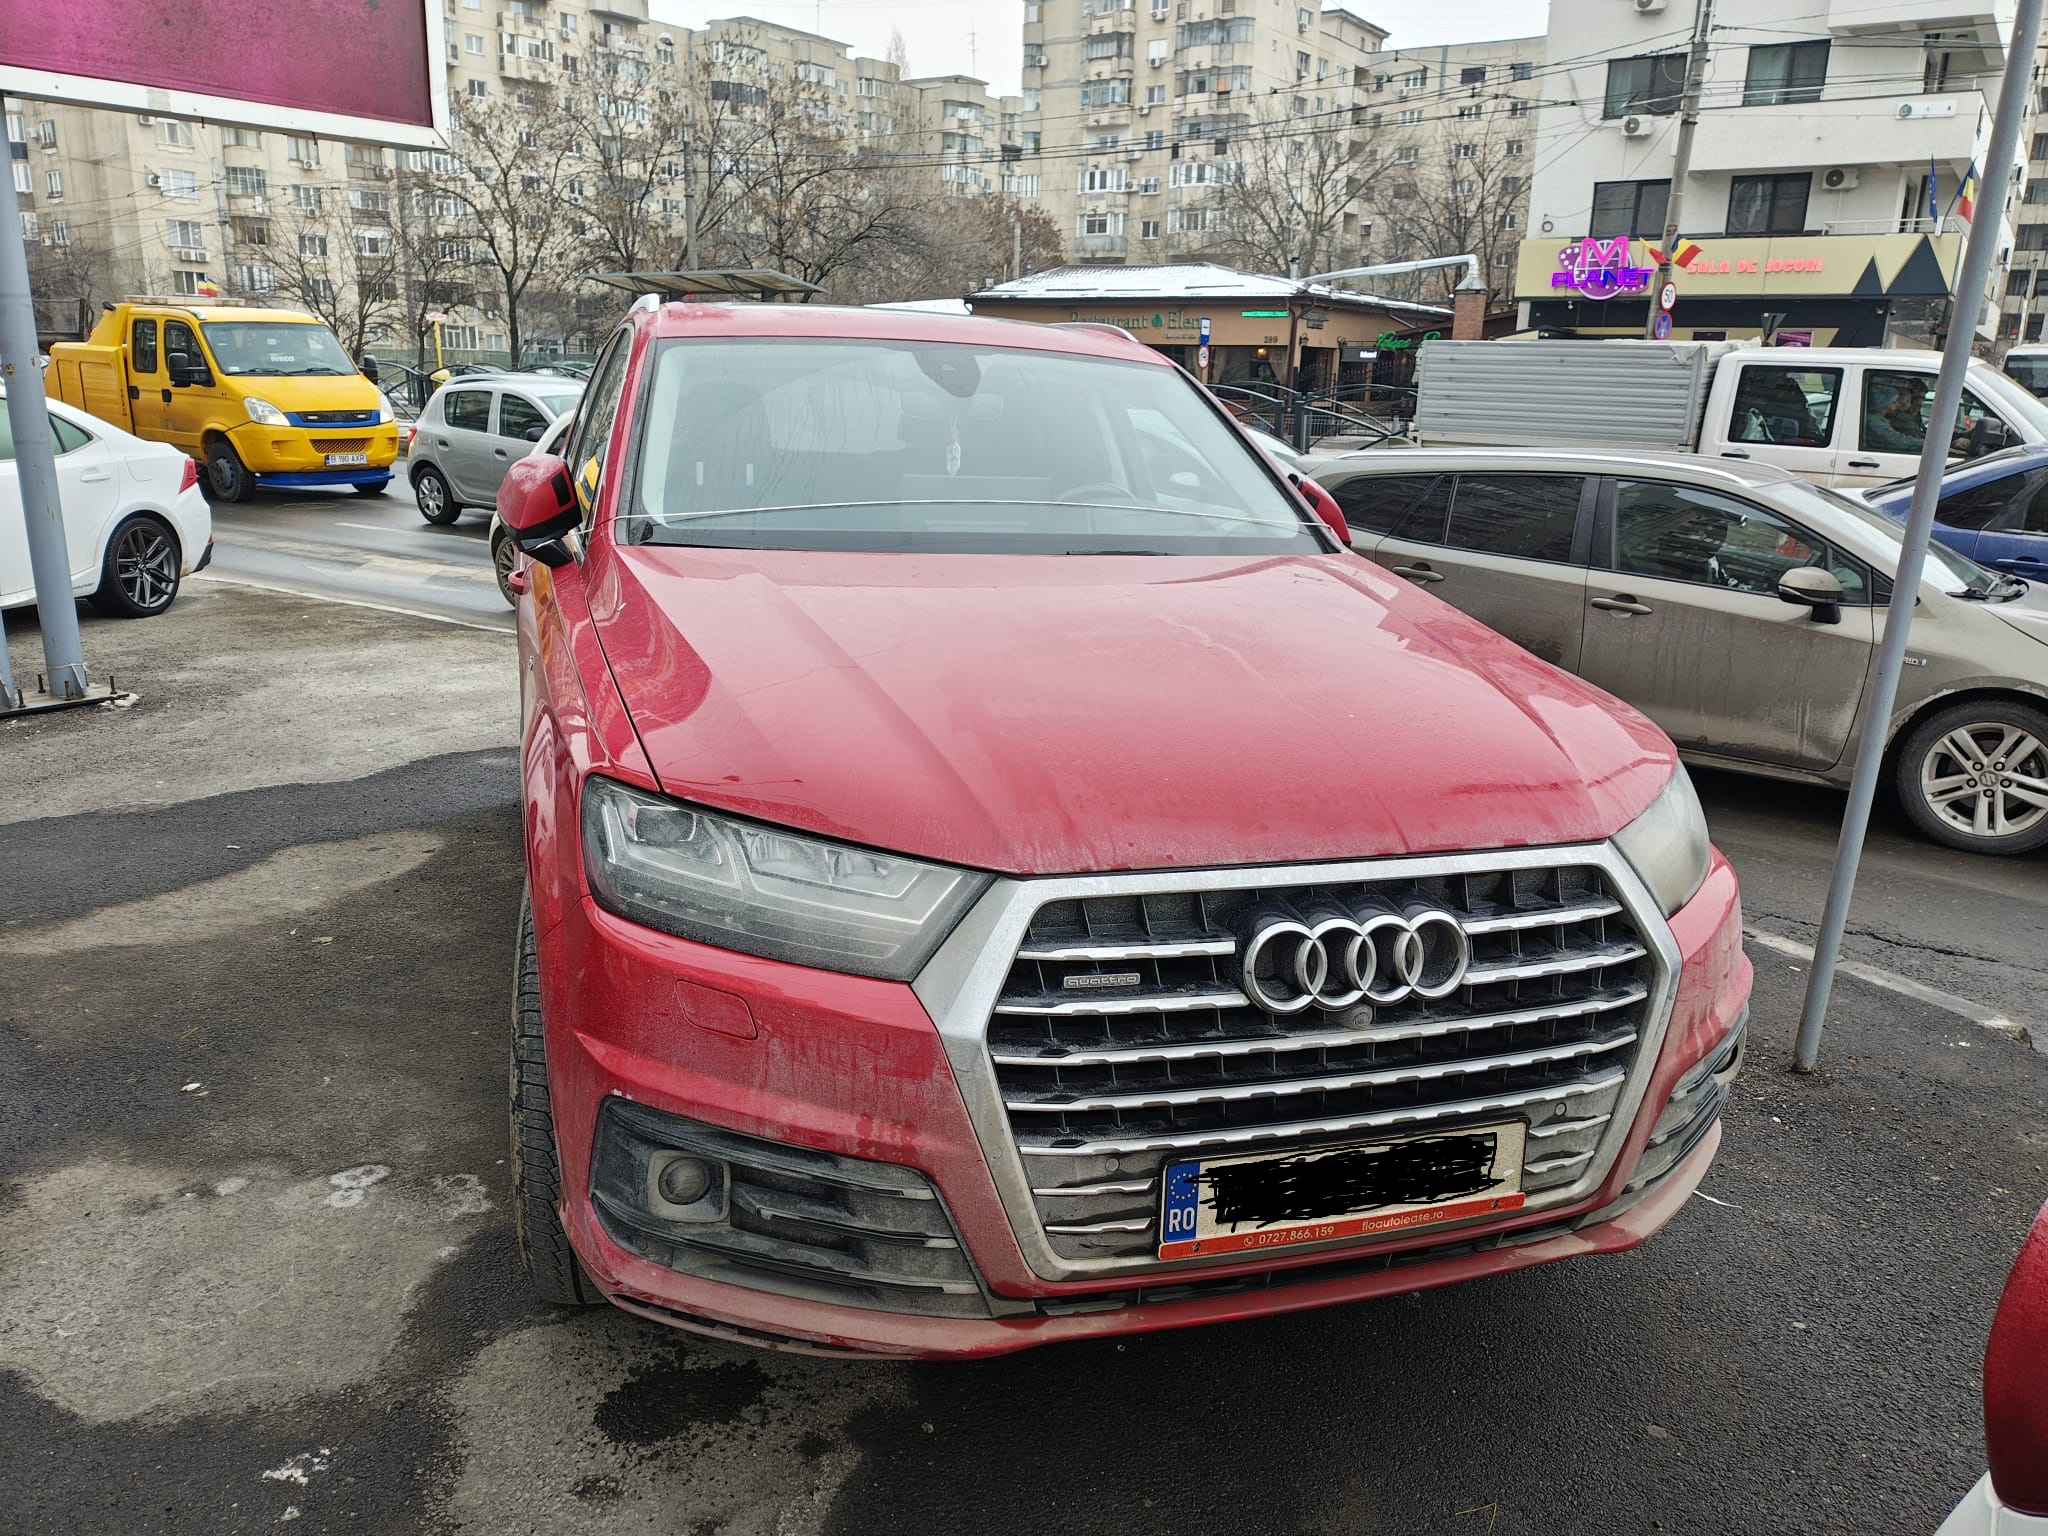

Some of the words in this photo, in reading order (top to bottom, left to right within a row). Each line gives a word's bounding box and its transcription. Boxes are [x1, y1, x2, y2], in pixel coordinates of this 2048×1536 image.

[1579, 235, 1630, 268] M
[1687, 259, 1730, 273] SALA
[1736, 259, 1758, 273] DE
[1551, 267, 1655, 288] PLANET
[1067, 975, 1137, 987] quattro
[1168, 1206, 1196, 1233] RO
[1258, 1226, 1335, 1244] 0727.866.159
